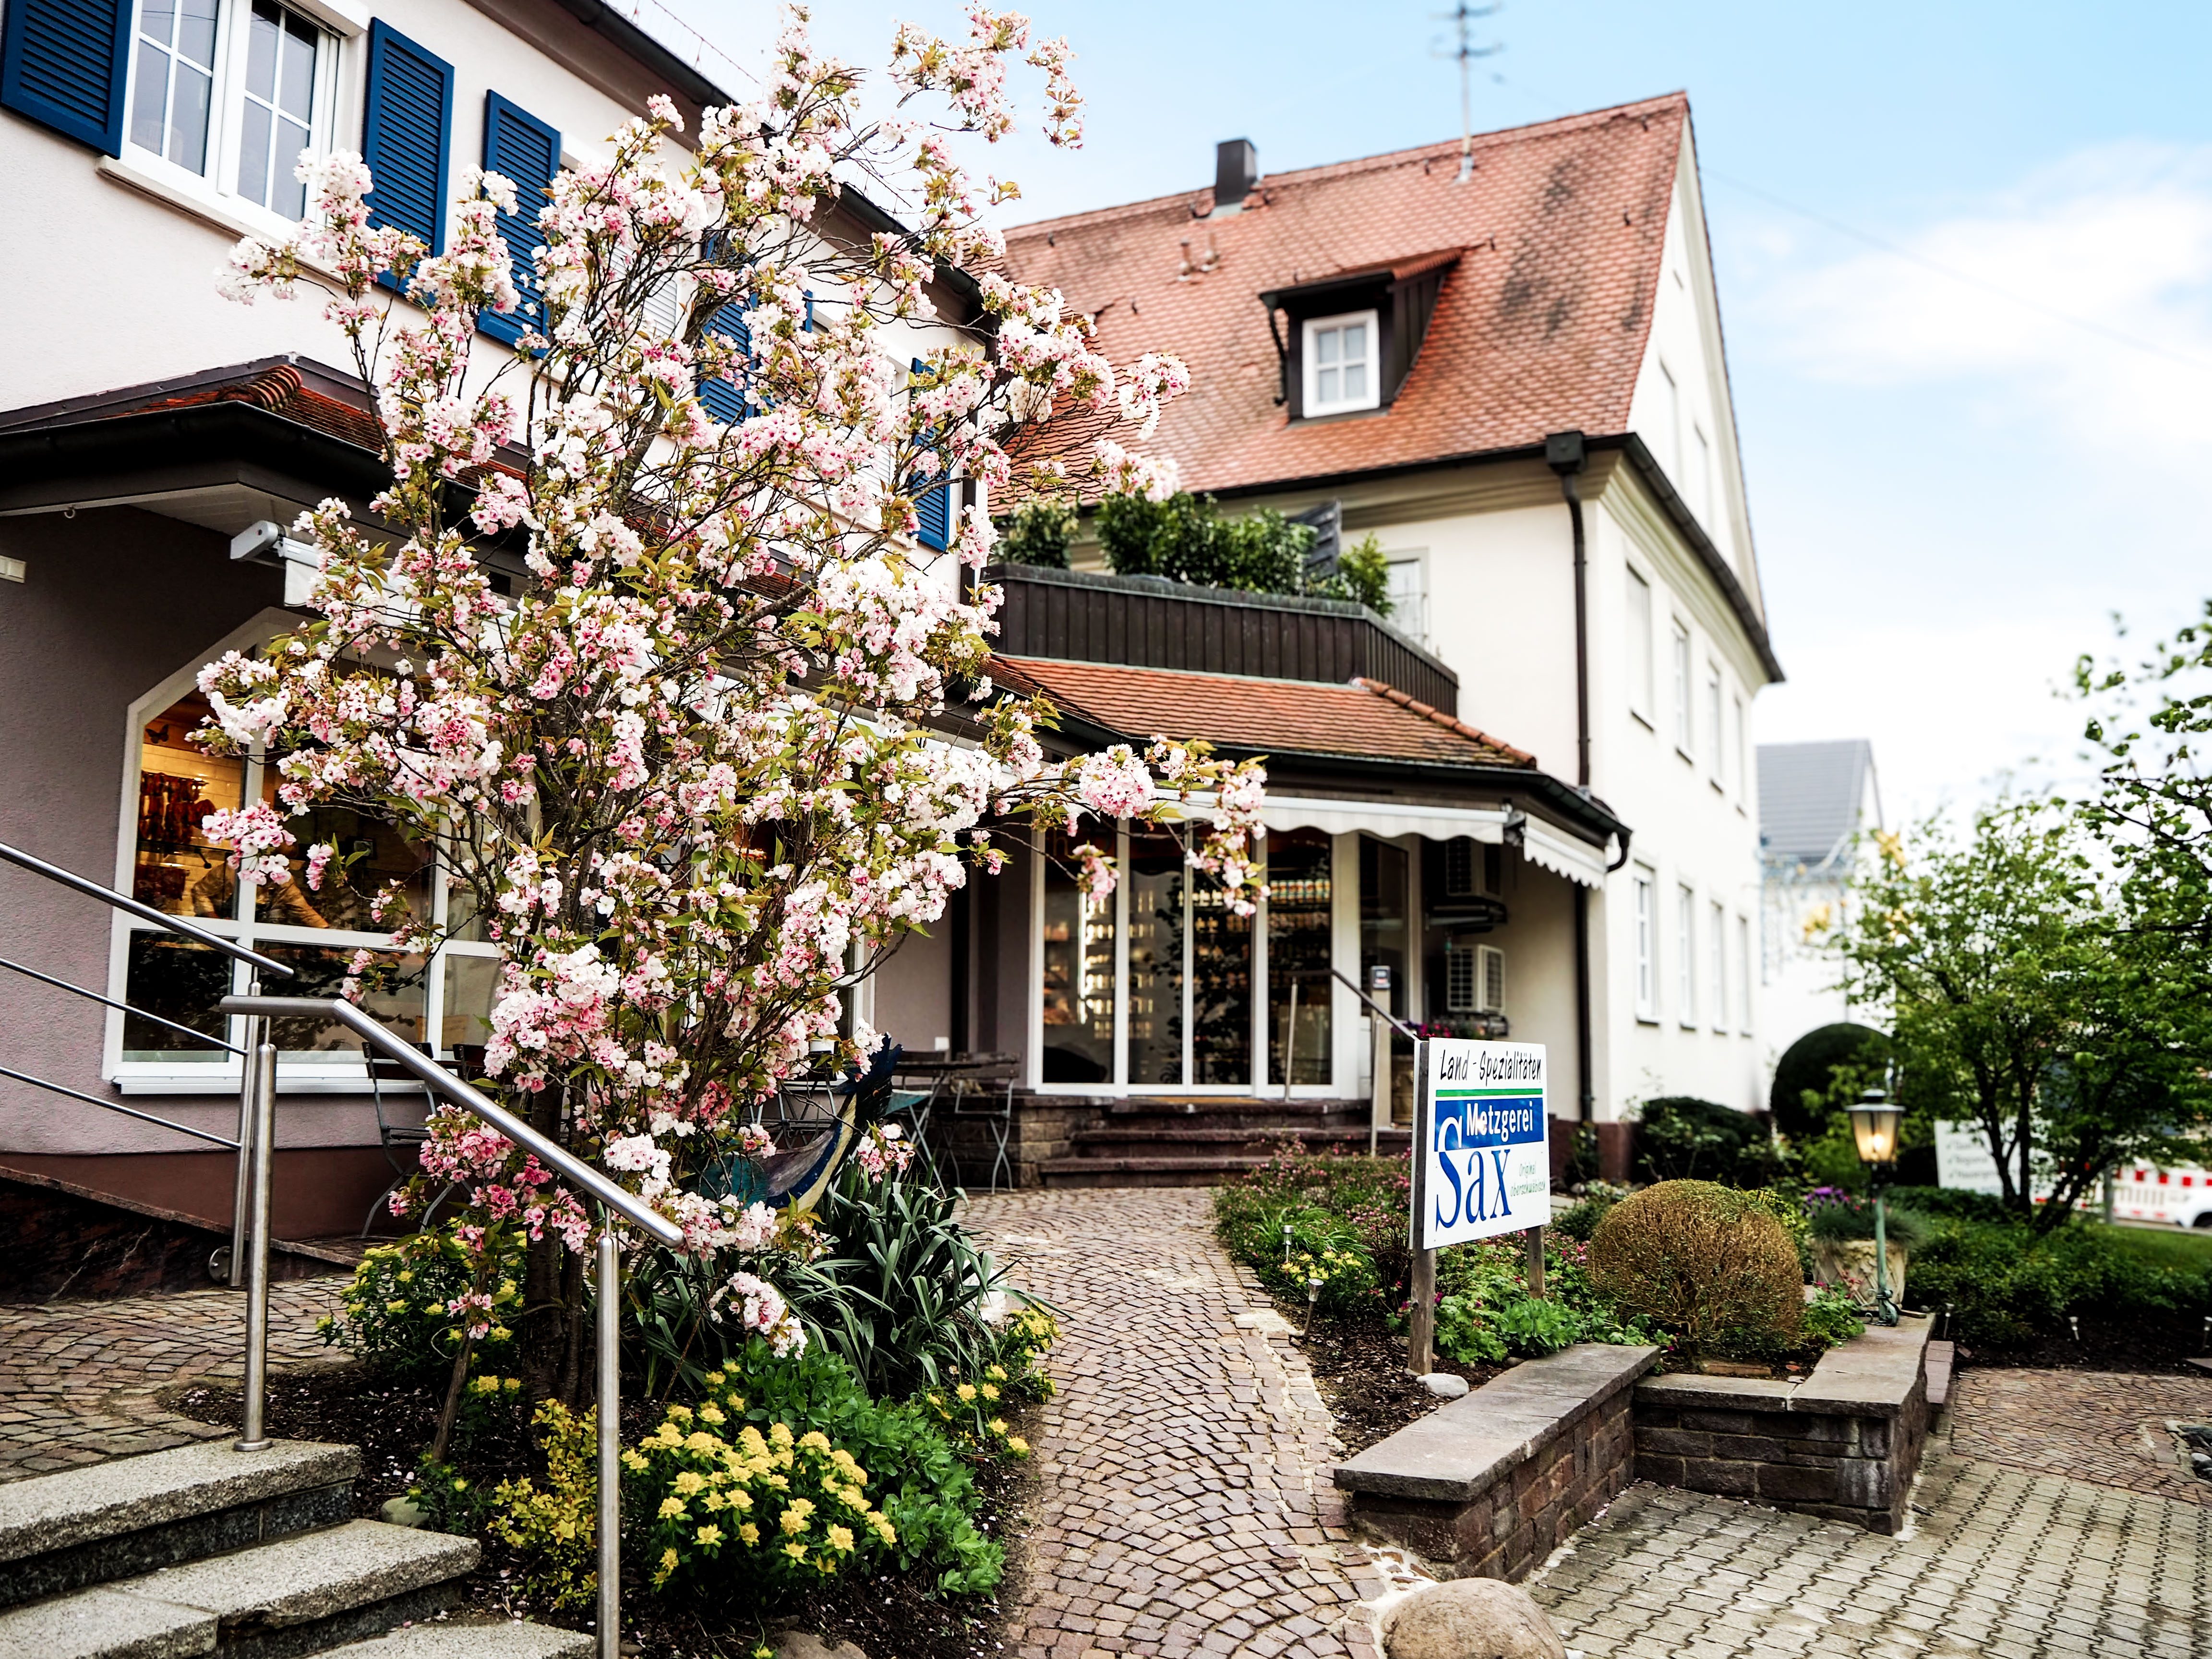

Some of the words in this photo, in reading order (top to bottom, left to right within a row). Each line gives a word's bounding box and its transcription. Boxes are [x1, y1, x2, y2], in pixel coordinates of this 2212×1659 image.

[1440, 1049, 1469, 1080] Land
[1479, 1050, 1541, 1086] Spezialitäten
[1467, 1101, 1533, 1142] Metzgerei
[1436, 1116, 1512, 1232] Sax
